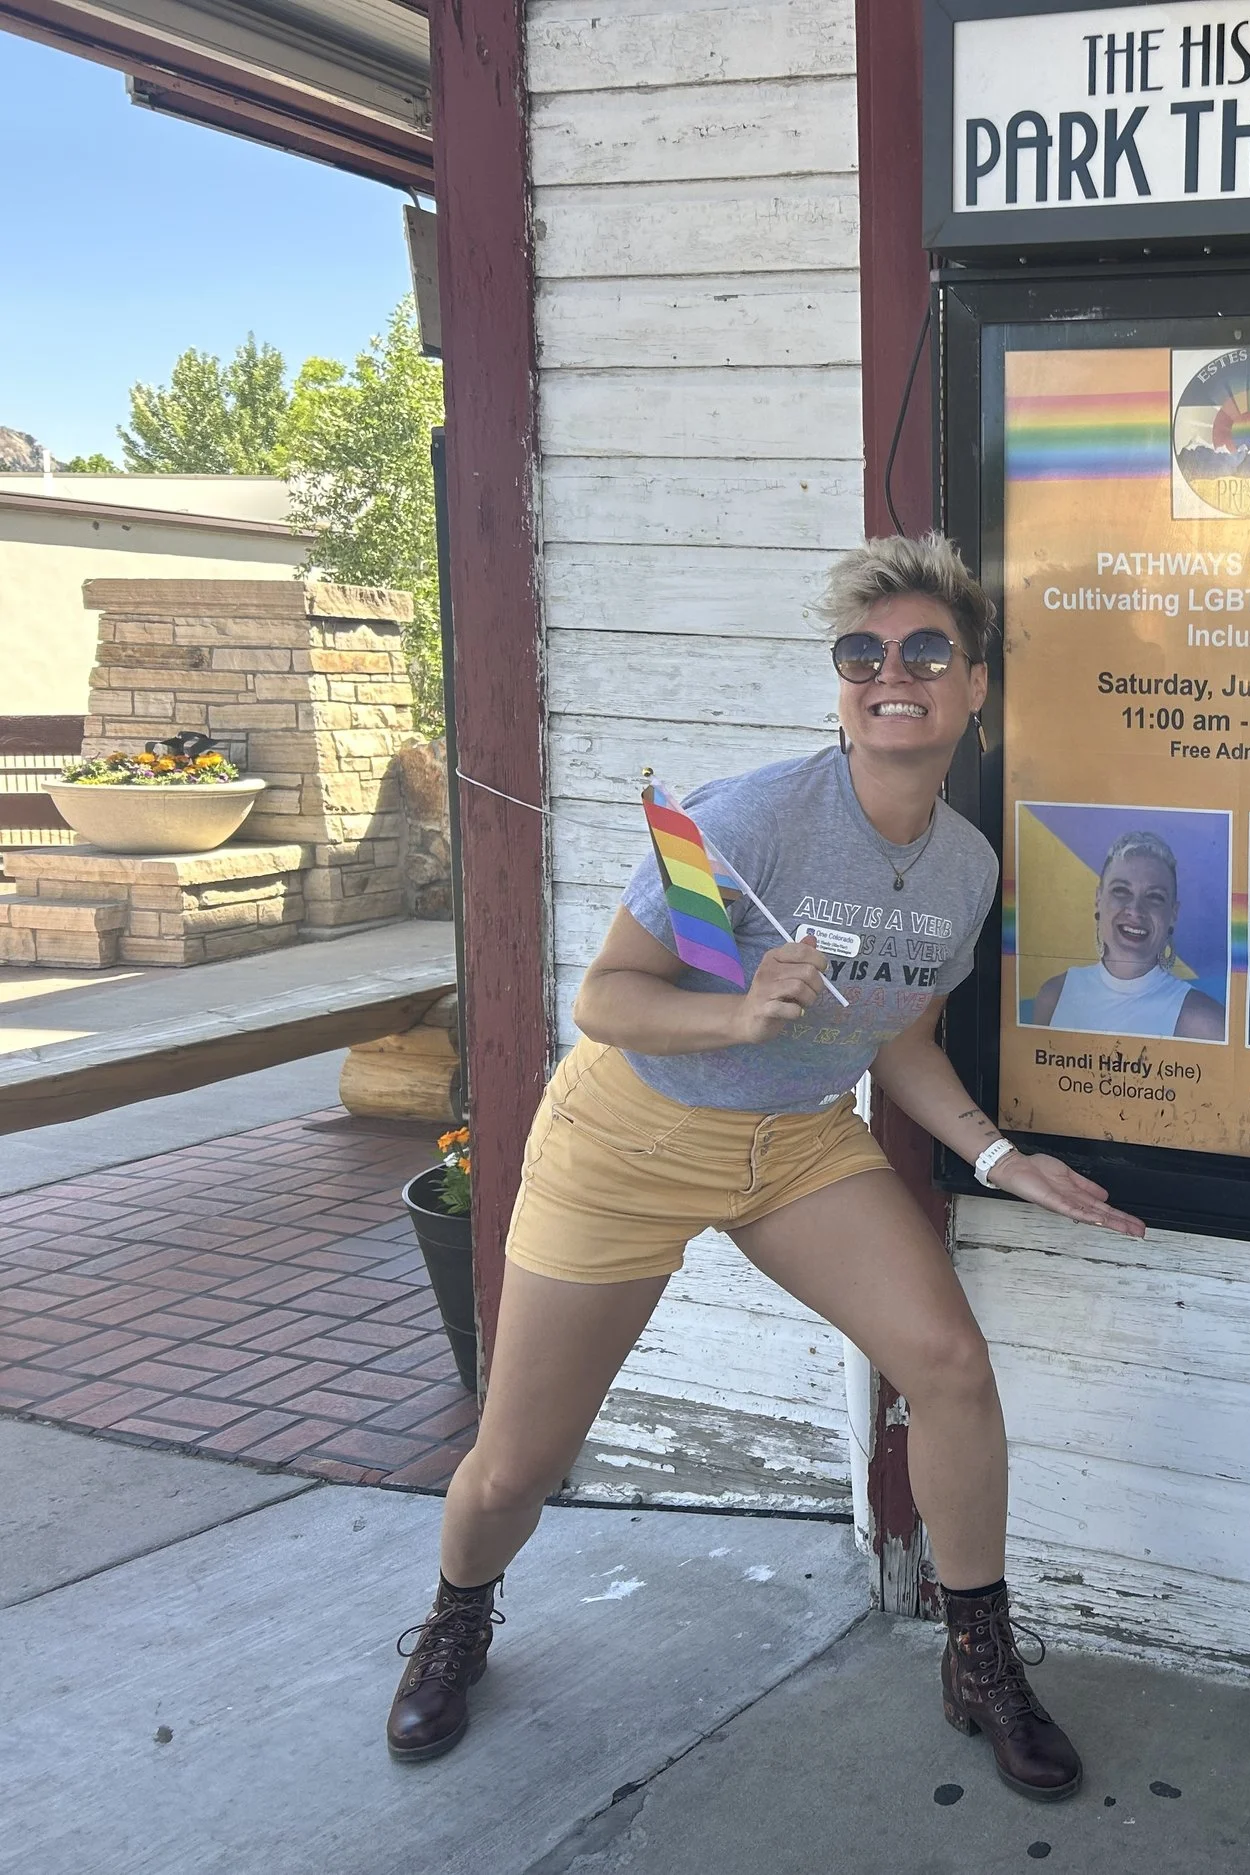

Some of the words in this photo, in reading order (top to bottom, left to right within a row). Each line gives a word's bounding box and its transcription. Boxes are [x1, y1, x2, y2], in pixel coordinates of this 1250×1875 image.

[1082, 28, 1166, 97] THE
[965, 105, 1151, 206] PARK
[1197, 350, 1248, 384] ESTES
[1096, 552, 1243, 575] PATHWAYS
[1043, 586, 1179, 617] Cultivating
[1097, 671, 1214, 702] Saturday,
[1122, 707, 1185, 731] 11:00
[1193, 713, 1231, 732] am
[1170, 741, 1211, 760] Free
[793, 896, 861, 926] ALLY
[863, 907, 883, 928] IS
[885, 909, 903, 931] A
[911, 911, 953, 939] VERB
[829, 932, 854, 944] Colorado
[879, 936, 898, 957] A
[849, 961, 869, 981] IS
[873, 962, 892, 982] A
[1034, 1049, 1093, 1071] Brandi
[1100, 1053, 1152, 1080] Hardy
[1157, 1060, 1203, 1082] (she)
[1058, 1075, 1094, 1094] One
[1099, 1078, 1177, 1102] Colorado
